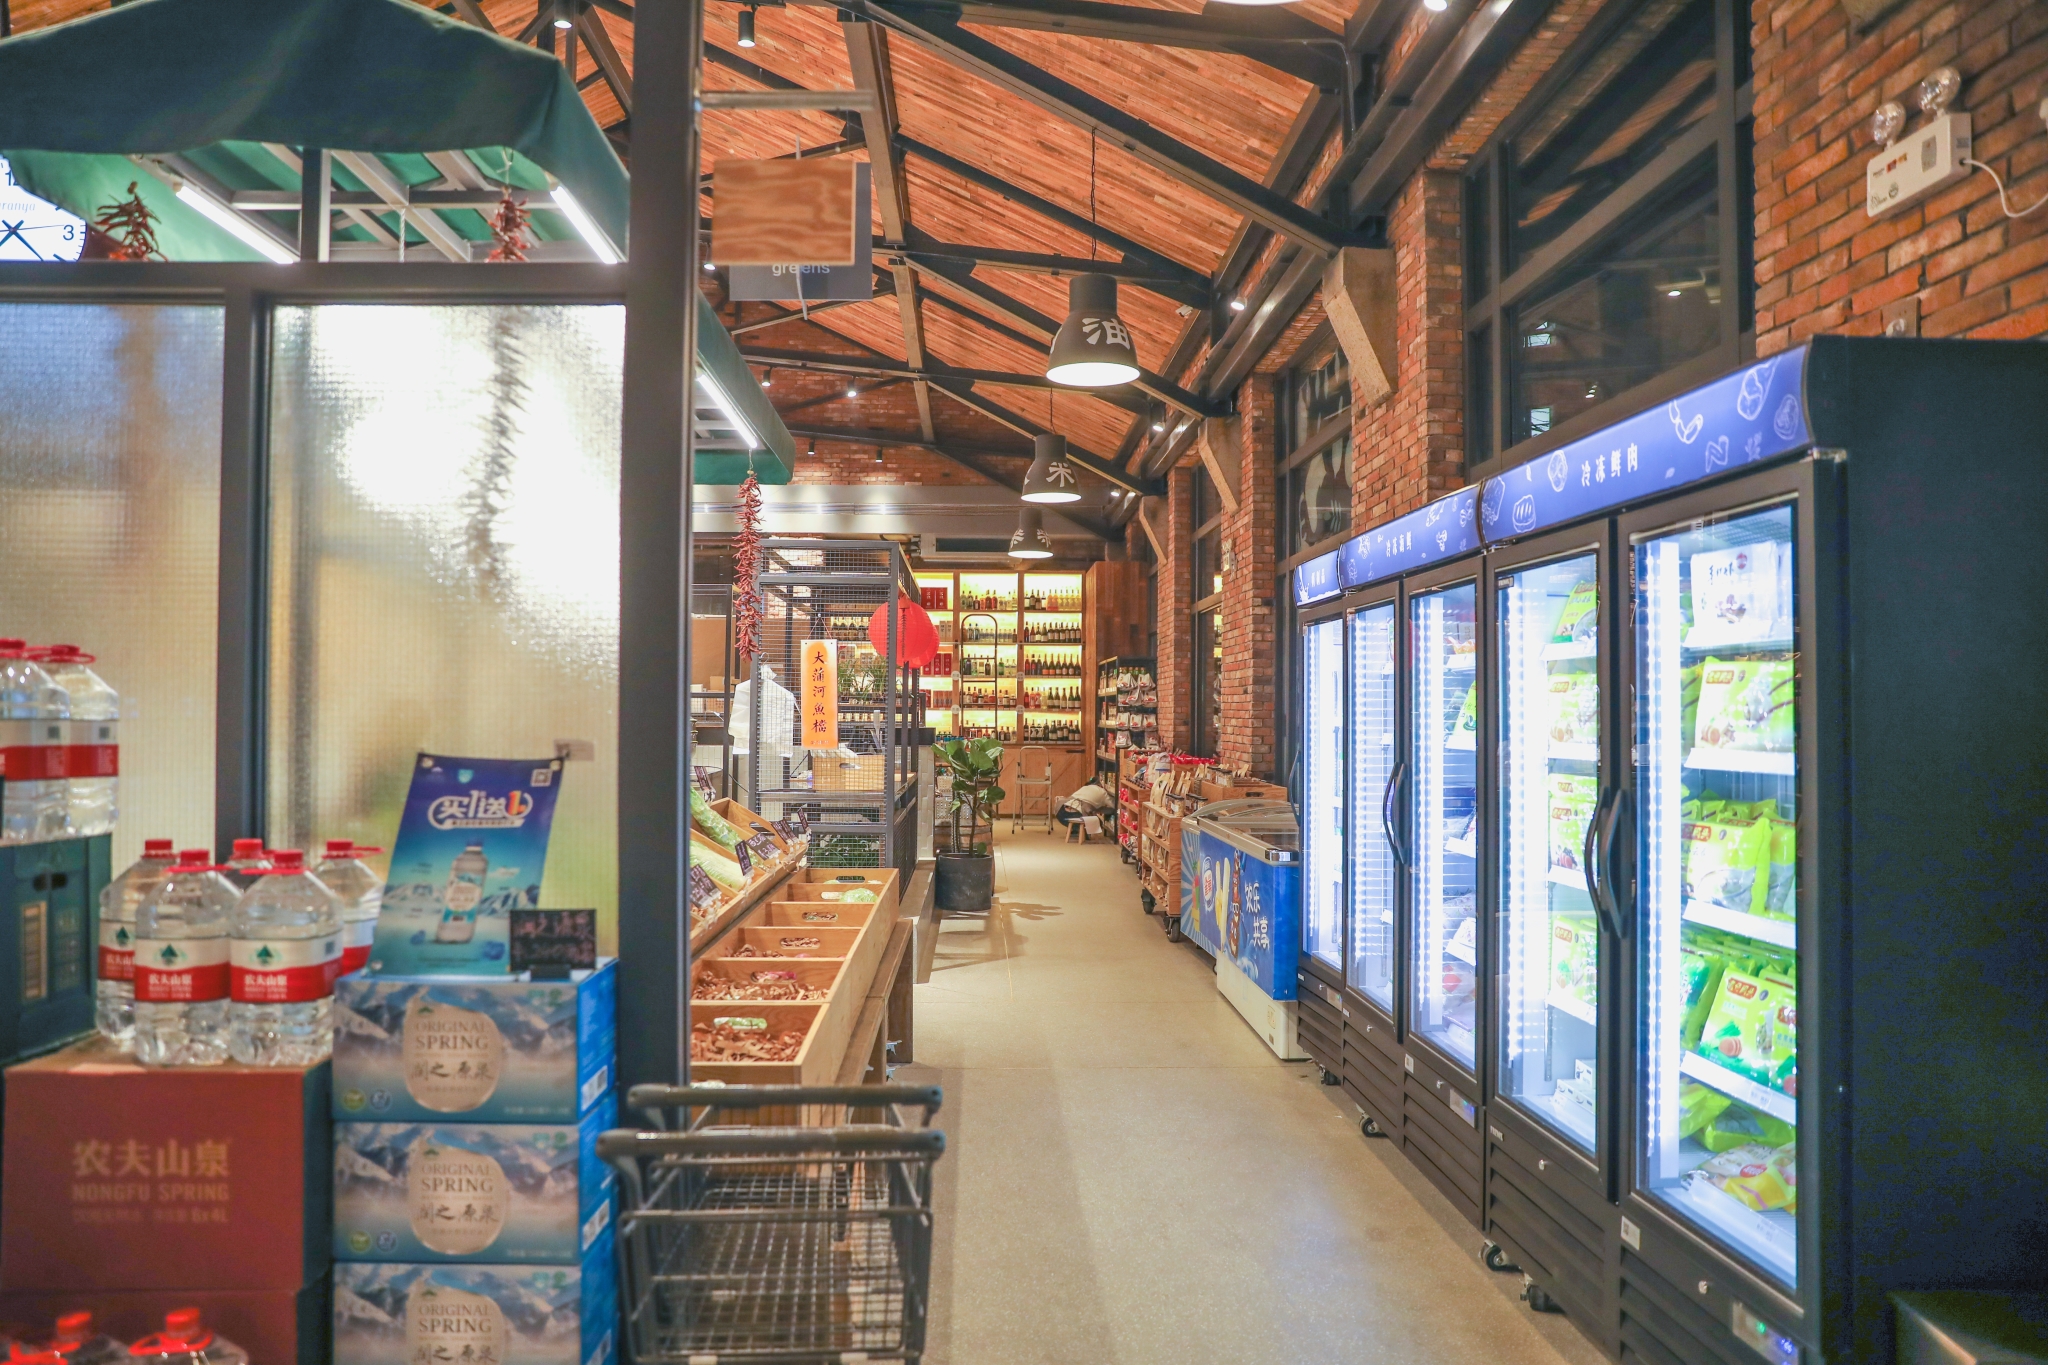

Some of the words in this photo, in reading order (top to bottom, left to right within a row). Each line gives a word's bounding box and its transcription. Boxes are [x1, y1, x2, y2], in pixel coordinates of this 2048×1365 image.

[63, 224, 74, 241] 3
[772, 263, 830, 276] greens
[1082, 318, 1130, 349] 油
[1046, 461, 1075, 488] 米
[148, 973, 193, 986] 农夫山泉
[244, 973, 288, 987] 农夫山泉
[415, 1021, 488, 1034] ORIGINAL
[416, 1035, 489, 1050] SPRING
[73, 1138, 230, 1177] 农夫山泉
[421, 1163, 492, 1176] ORIGINAL
[72, 1182, 150, 1202] NONGFU
[157, 1182, 230, 1202] SPRING
[421, 1177, 495, 1193] SPRING
[418, 1303, 490, 1317] ORIGINAL
[418, 1318, 493, 1333] SPRING
